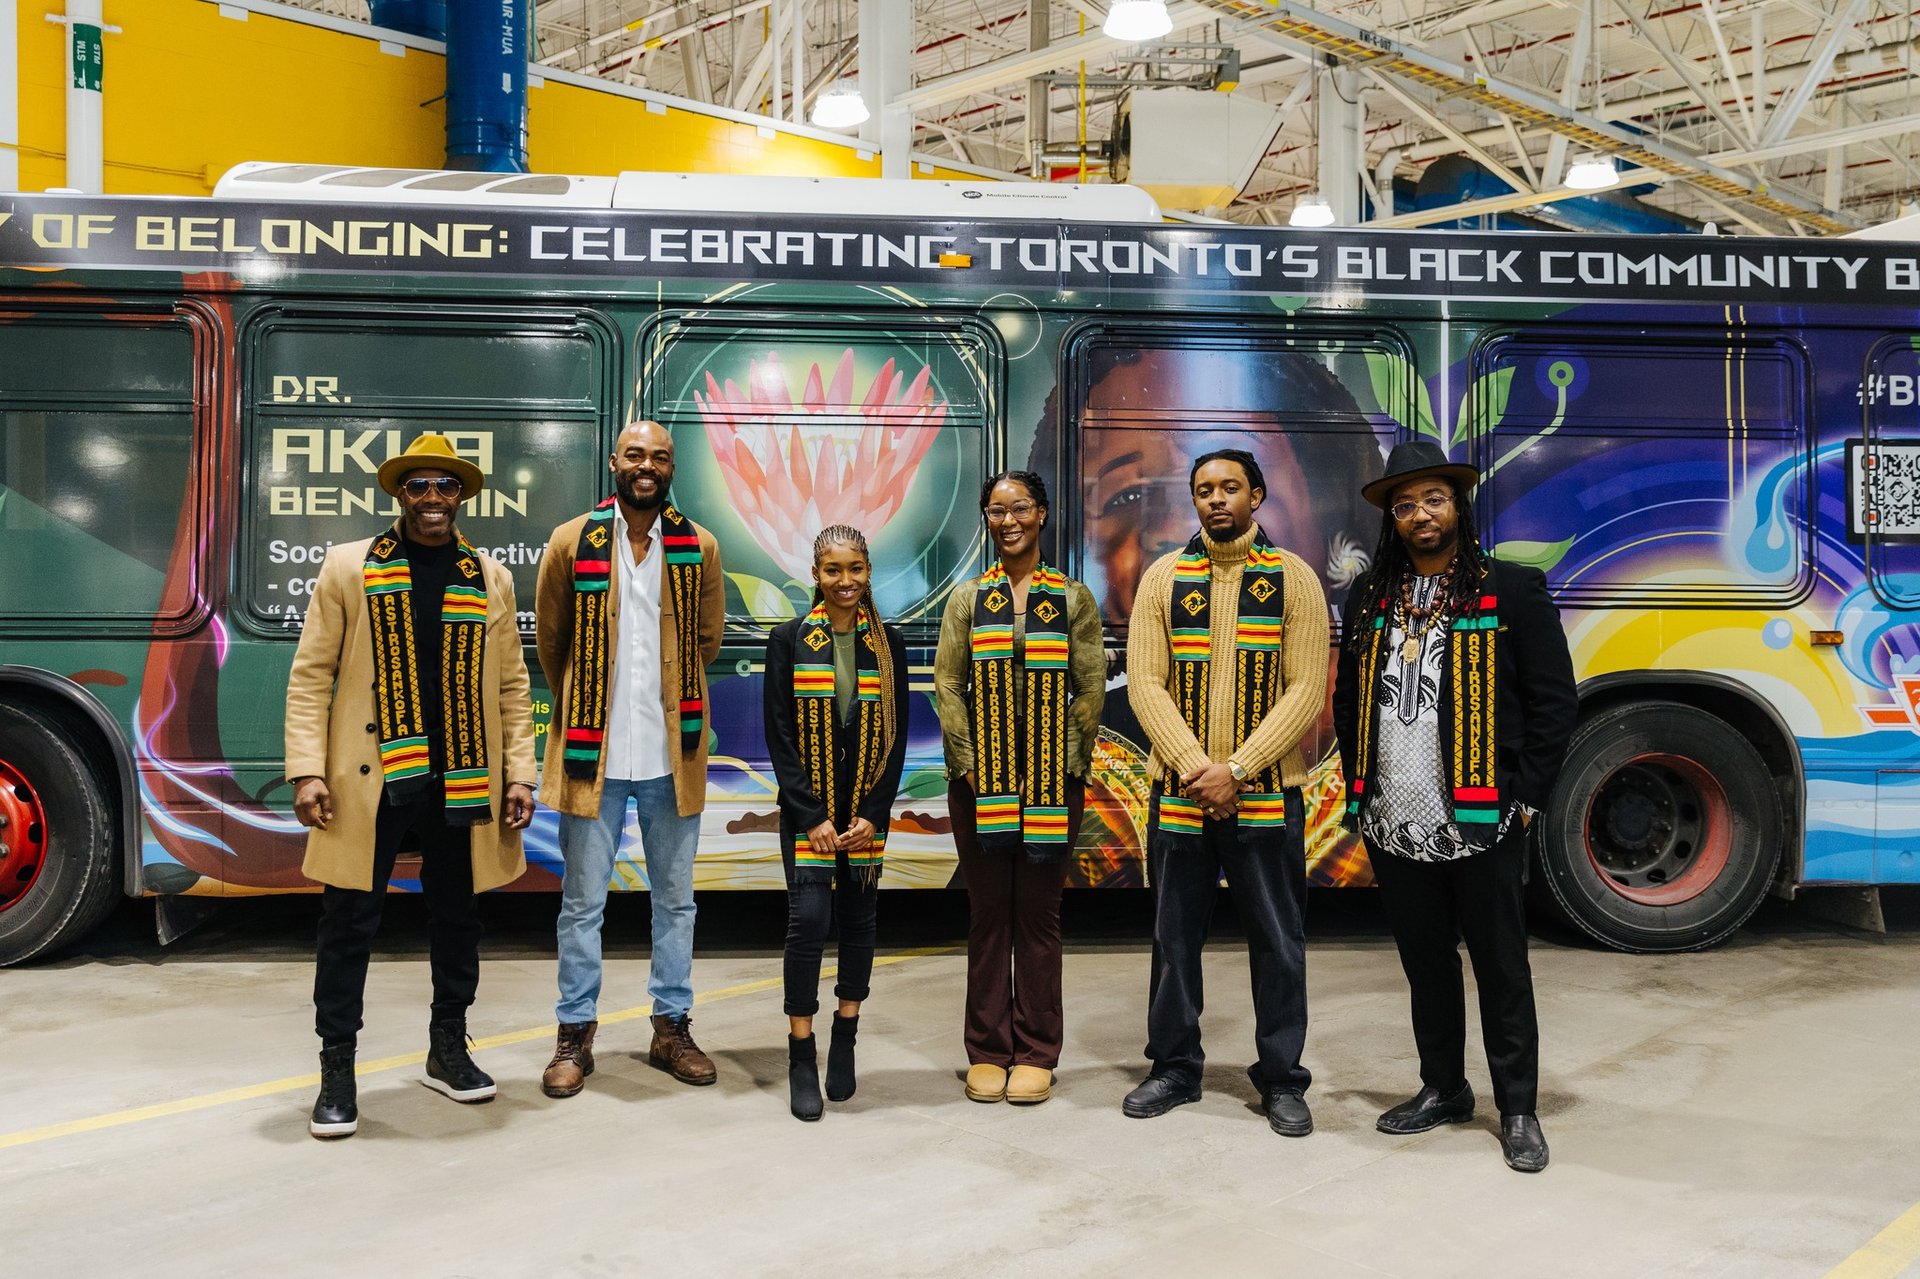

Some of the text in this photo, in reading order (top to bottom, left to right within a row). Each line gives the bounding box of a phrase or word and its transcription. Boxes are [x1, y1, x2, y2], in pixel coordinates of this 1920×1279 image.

[77, 40, 86, 61] STM
[93, 43, 101, 65] STM
[32, 213, 116, 249] OF
[136, 216, 508, 258] BELONGING:
[530, 225, 958, 269] CELEBRATING
[975, 237, 1318, 279] TORONTO'S
[1337, 246, 1522, 284] BLACK
[1540, 251, 1869, 290] COMMUNITY
[273, 376, 352, 402] DR.
[1856, 374, 1920, 406] #B
[270, 486, 527, 517] BENJIN
[384, 594, 409, 736] ASTROSANKOFA
[455, 623, 473, 767] ASTROSANKOFA
[583, 594, 596, 726] ASTROSANKOFA
[685, 565, 693, 698] ASTROSANKOFA
[988, 660, 1002, 793] ASTROSANKOFA
[1041, 672, 1052, 805] ASTROSANKOFA
[1469, 633, 1481, 786] ASTROSANKOFA
